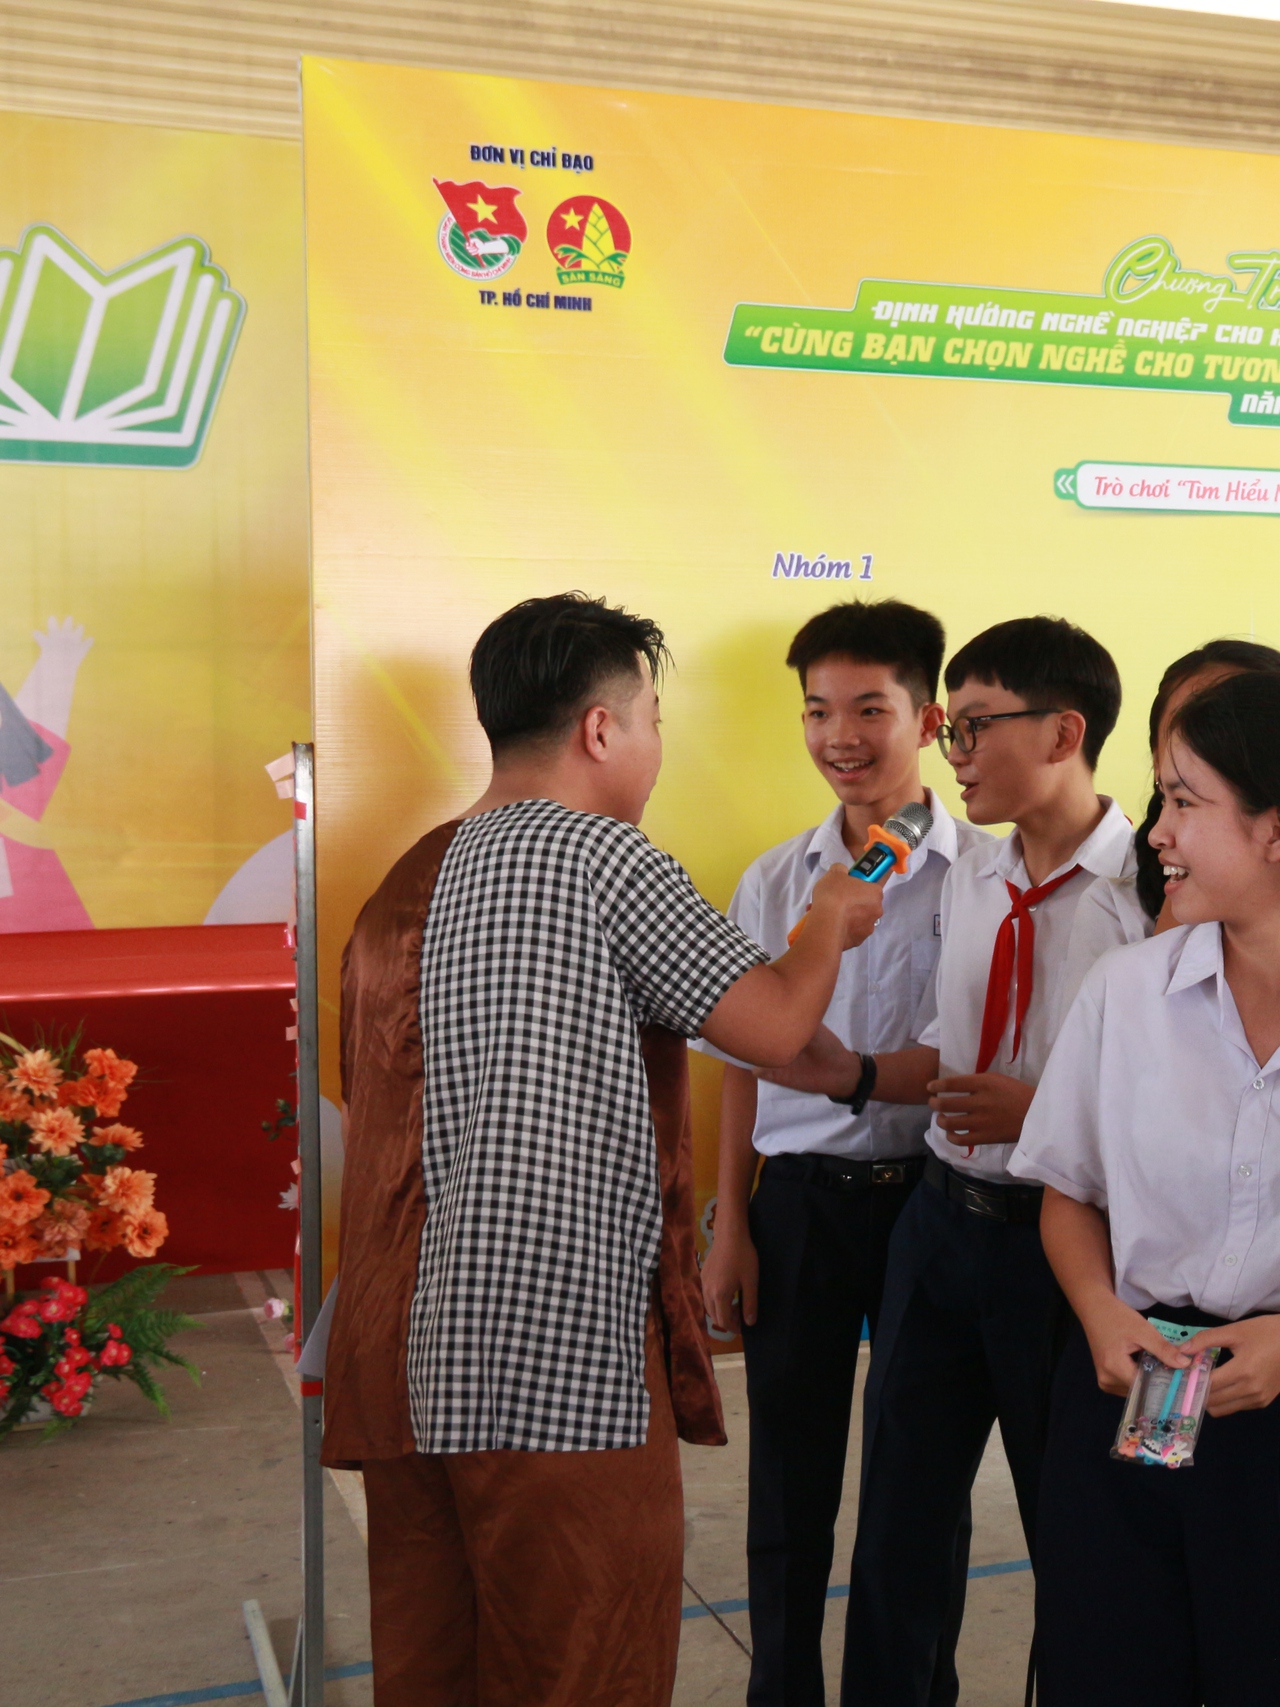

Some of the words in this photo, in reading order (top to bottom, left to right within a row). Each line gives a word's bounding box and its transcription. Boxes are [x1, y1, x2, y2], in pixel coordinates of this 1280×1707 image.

[470, 144, 505, 163] ĐƠN
[509, 148, 525, 168] VỊ
[530, 147, 556, 168] CHỈ
[561, 153, 594, 173] ĐẠO
[1111, 242, 1245, 313] Chương
[479, 290, 498, 305] TP.
[502, 288, 522, 307] HỒ
[526, 292, 551, 309] CHÍ
[554, 295, 592, 311] MINH
[871, 300, 939, 328] ĐỊNH
[945, 301, 1035, 330] HƯỚNG
[1041, 310, 1116, 336] NGHỀ
[1116, 313, 1211, 346] NGHIỆP
[1215, 323, 1263, 345] CHO
[744, 322, 855, 359] “CÙNG
[861, 333, 936, 365] BẠN
[942, 337, 1034, 371] CHỌN
[1039, 338, 1127, 374] NGHỀ
[1134, 350, 1195, 378] CHO
[1094, 476, 1123, 497] Trò
[1129, 478, 1171, 499] chơi
[1225, 478, 1270, 503] Hiểu
[772, 552, 853, 579] Nhóm
[859, 554, 873, 579] 1
